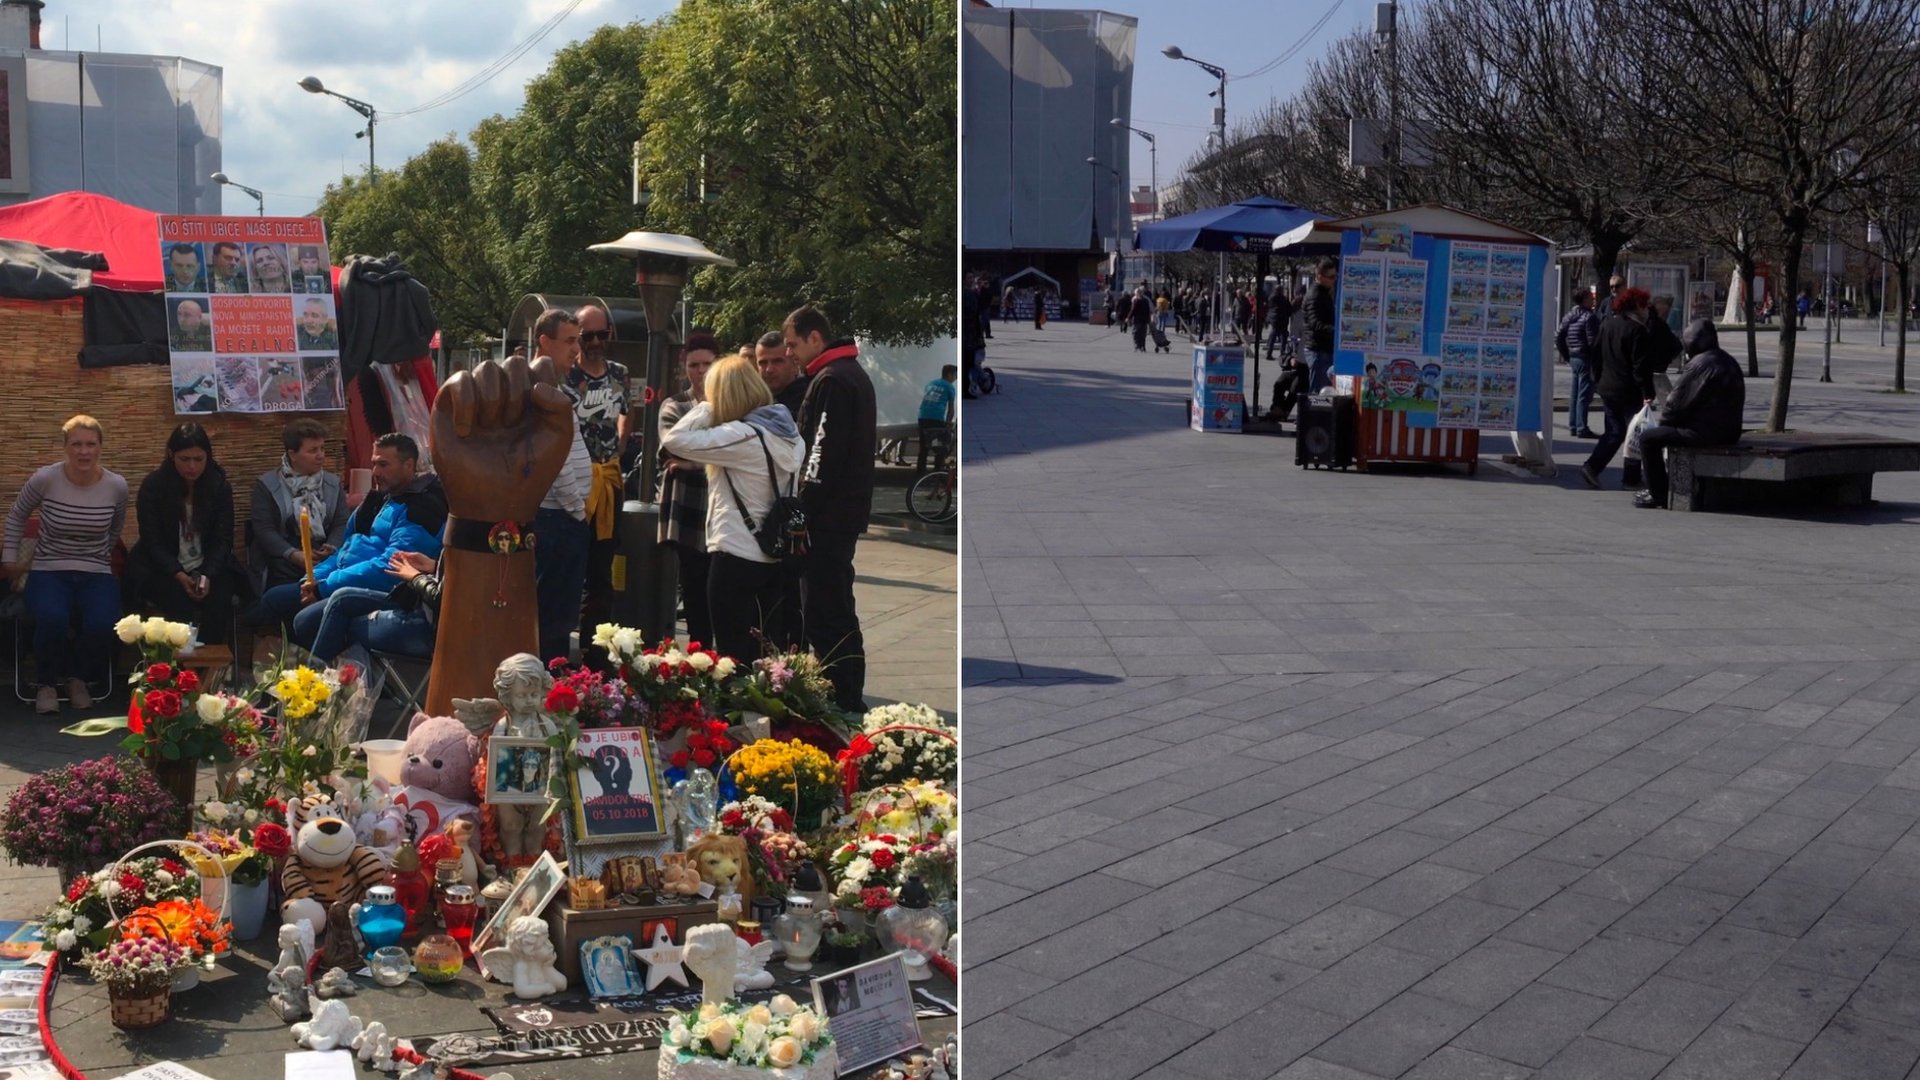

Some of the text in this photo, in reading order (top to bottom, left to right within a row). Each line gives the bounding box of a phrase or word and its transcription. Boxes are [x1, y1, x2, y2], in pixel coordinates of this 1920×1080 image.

[164, 222, 179, 236] KO
[182, 217, 207, 236] ŠTITI
[210, 221, 240, 237] UBICE
[246, 219, 273, 237] NAŠE
[252, 298, 291, 308] OTVORITE
[214, 311, 293, 321] NOVA MINISTARSTVA
[214, 321, 294, 335] DA MOŽETE RADITI
[214, 338, 296, 352] LEGALNO
[583, 387, 613, 406] NIKE
[264, 401, 303, 411] DROGA
[596, 733, 608, 743] JE
[611, 732, 640, 742] UBIO
[576, 746, 641, 759] DAVIDA
[585, 793, 650, 806] DAVIDOV TRG
